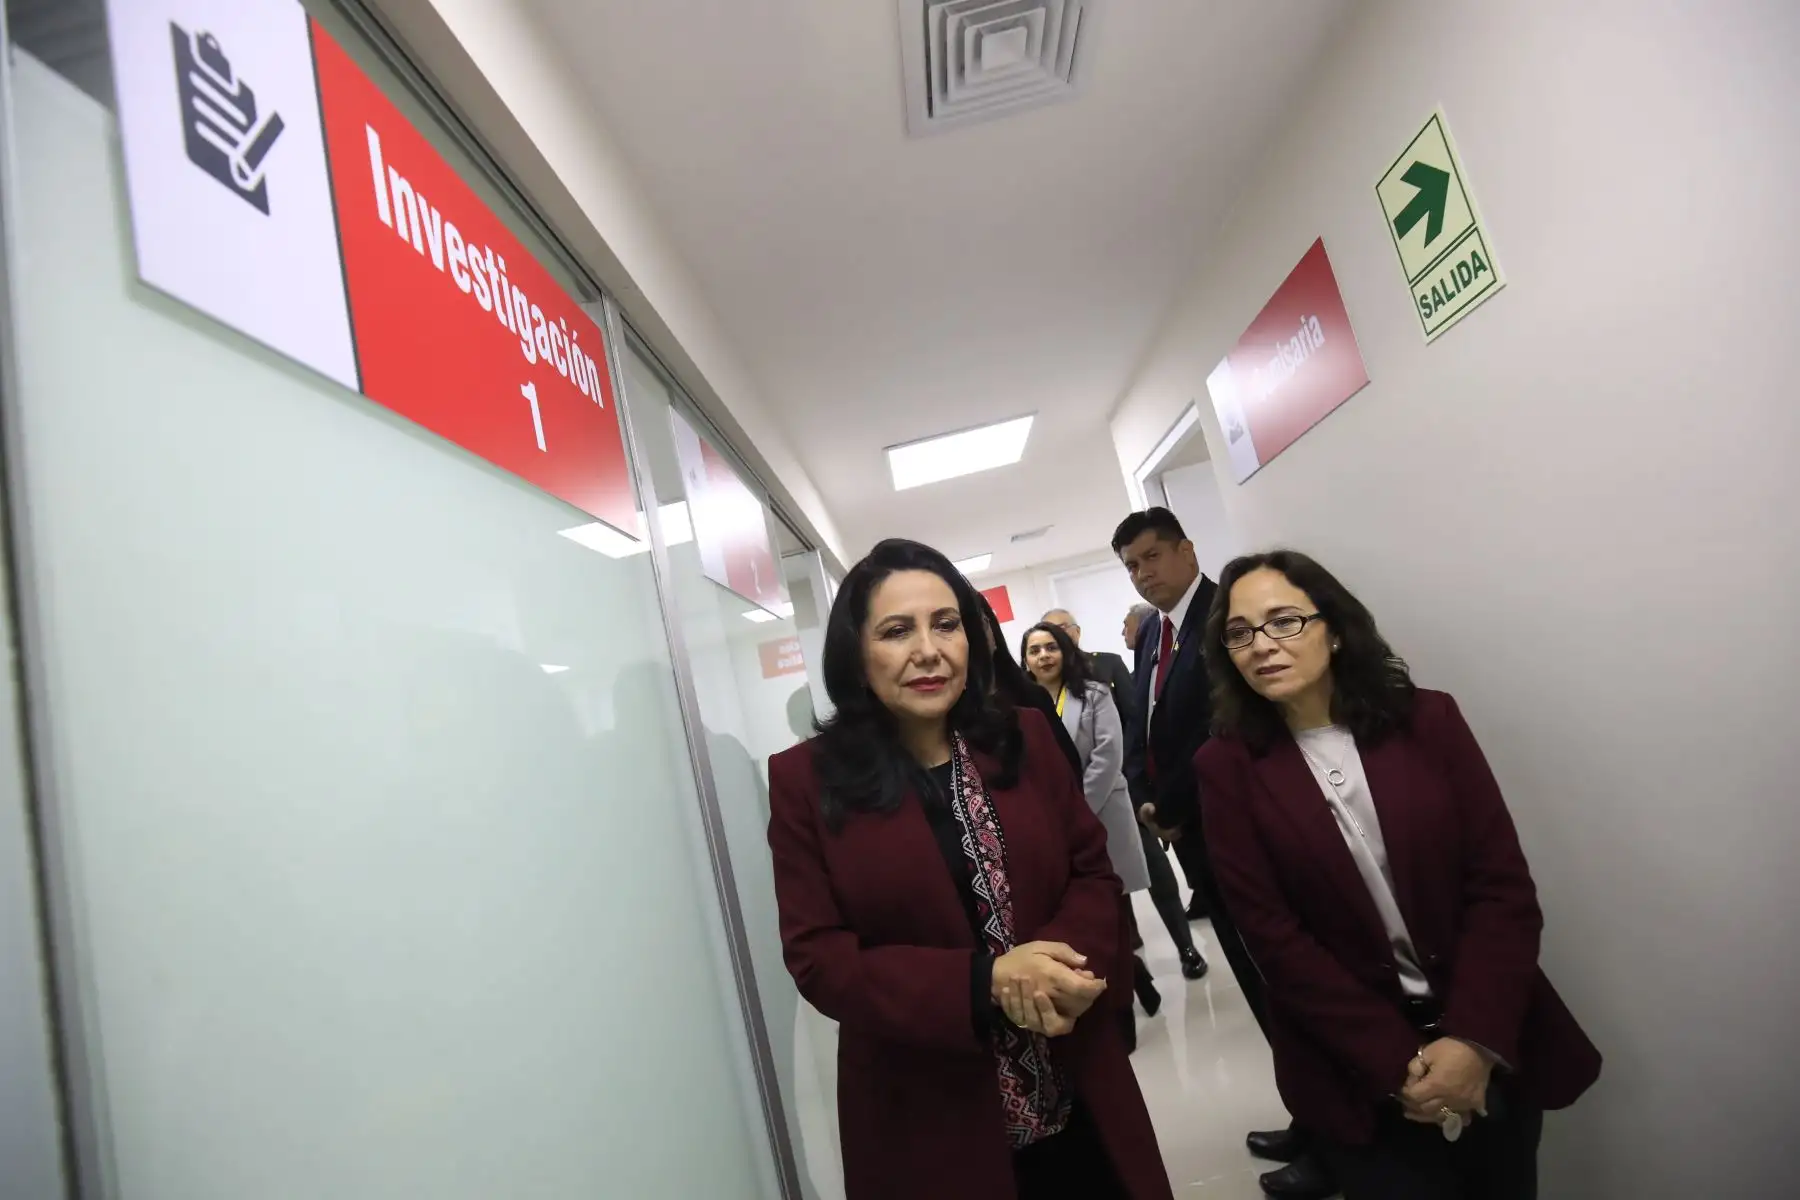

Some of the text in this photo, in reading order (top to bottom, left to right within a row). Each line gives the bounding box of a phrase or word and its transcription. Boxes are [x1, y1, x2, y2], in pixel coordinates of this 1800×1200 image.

[365, 122, 604, 409] Investigación
[1419, 249, 1488, 319] SALIDA
[520, 380, 547, 453] 1
